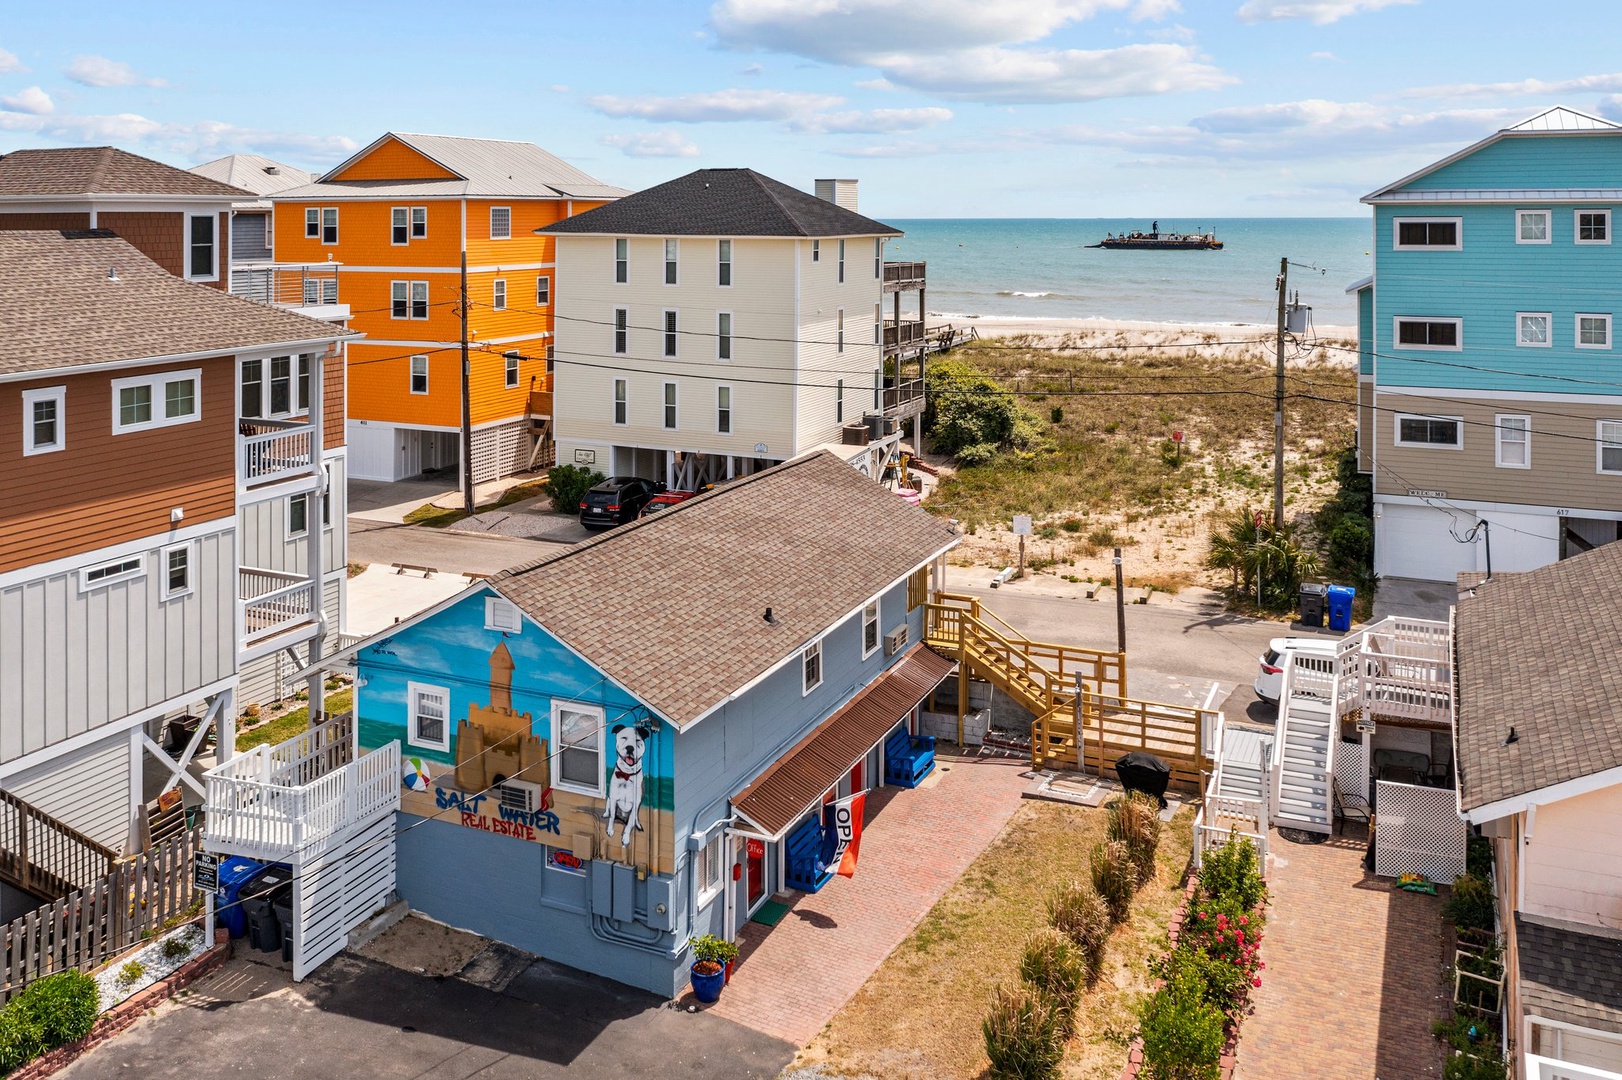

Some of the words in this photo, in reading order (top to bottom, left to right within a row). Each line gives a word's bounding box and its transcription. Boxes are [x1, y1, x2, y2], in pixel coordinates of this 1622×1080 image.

[435, 787, 487, 814] SALT
[498, 804, 560, 835] WATER
[461, 812, 490, 832] REAL
[492, 817, 536, 840] ESTATE
[833, 808, 851, 864] OPEN
[747, 842, 763, 855] Office
[195, 860, 216, 870] PARKING
[202, 855, 211, 863] NO
[553, 851, 580, 869] OPEN
